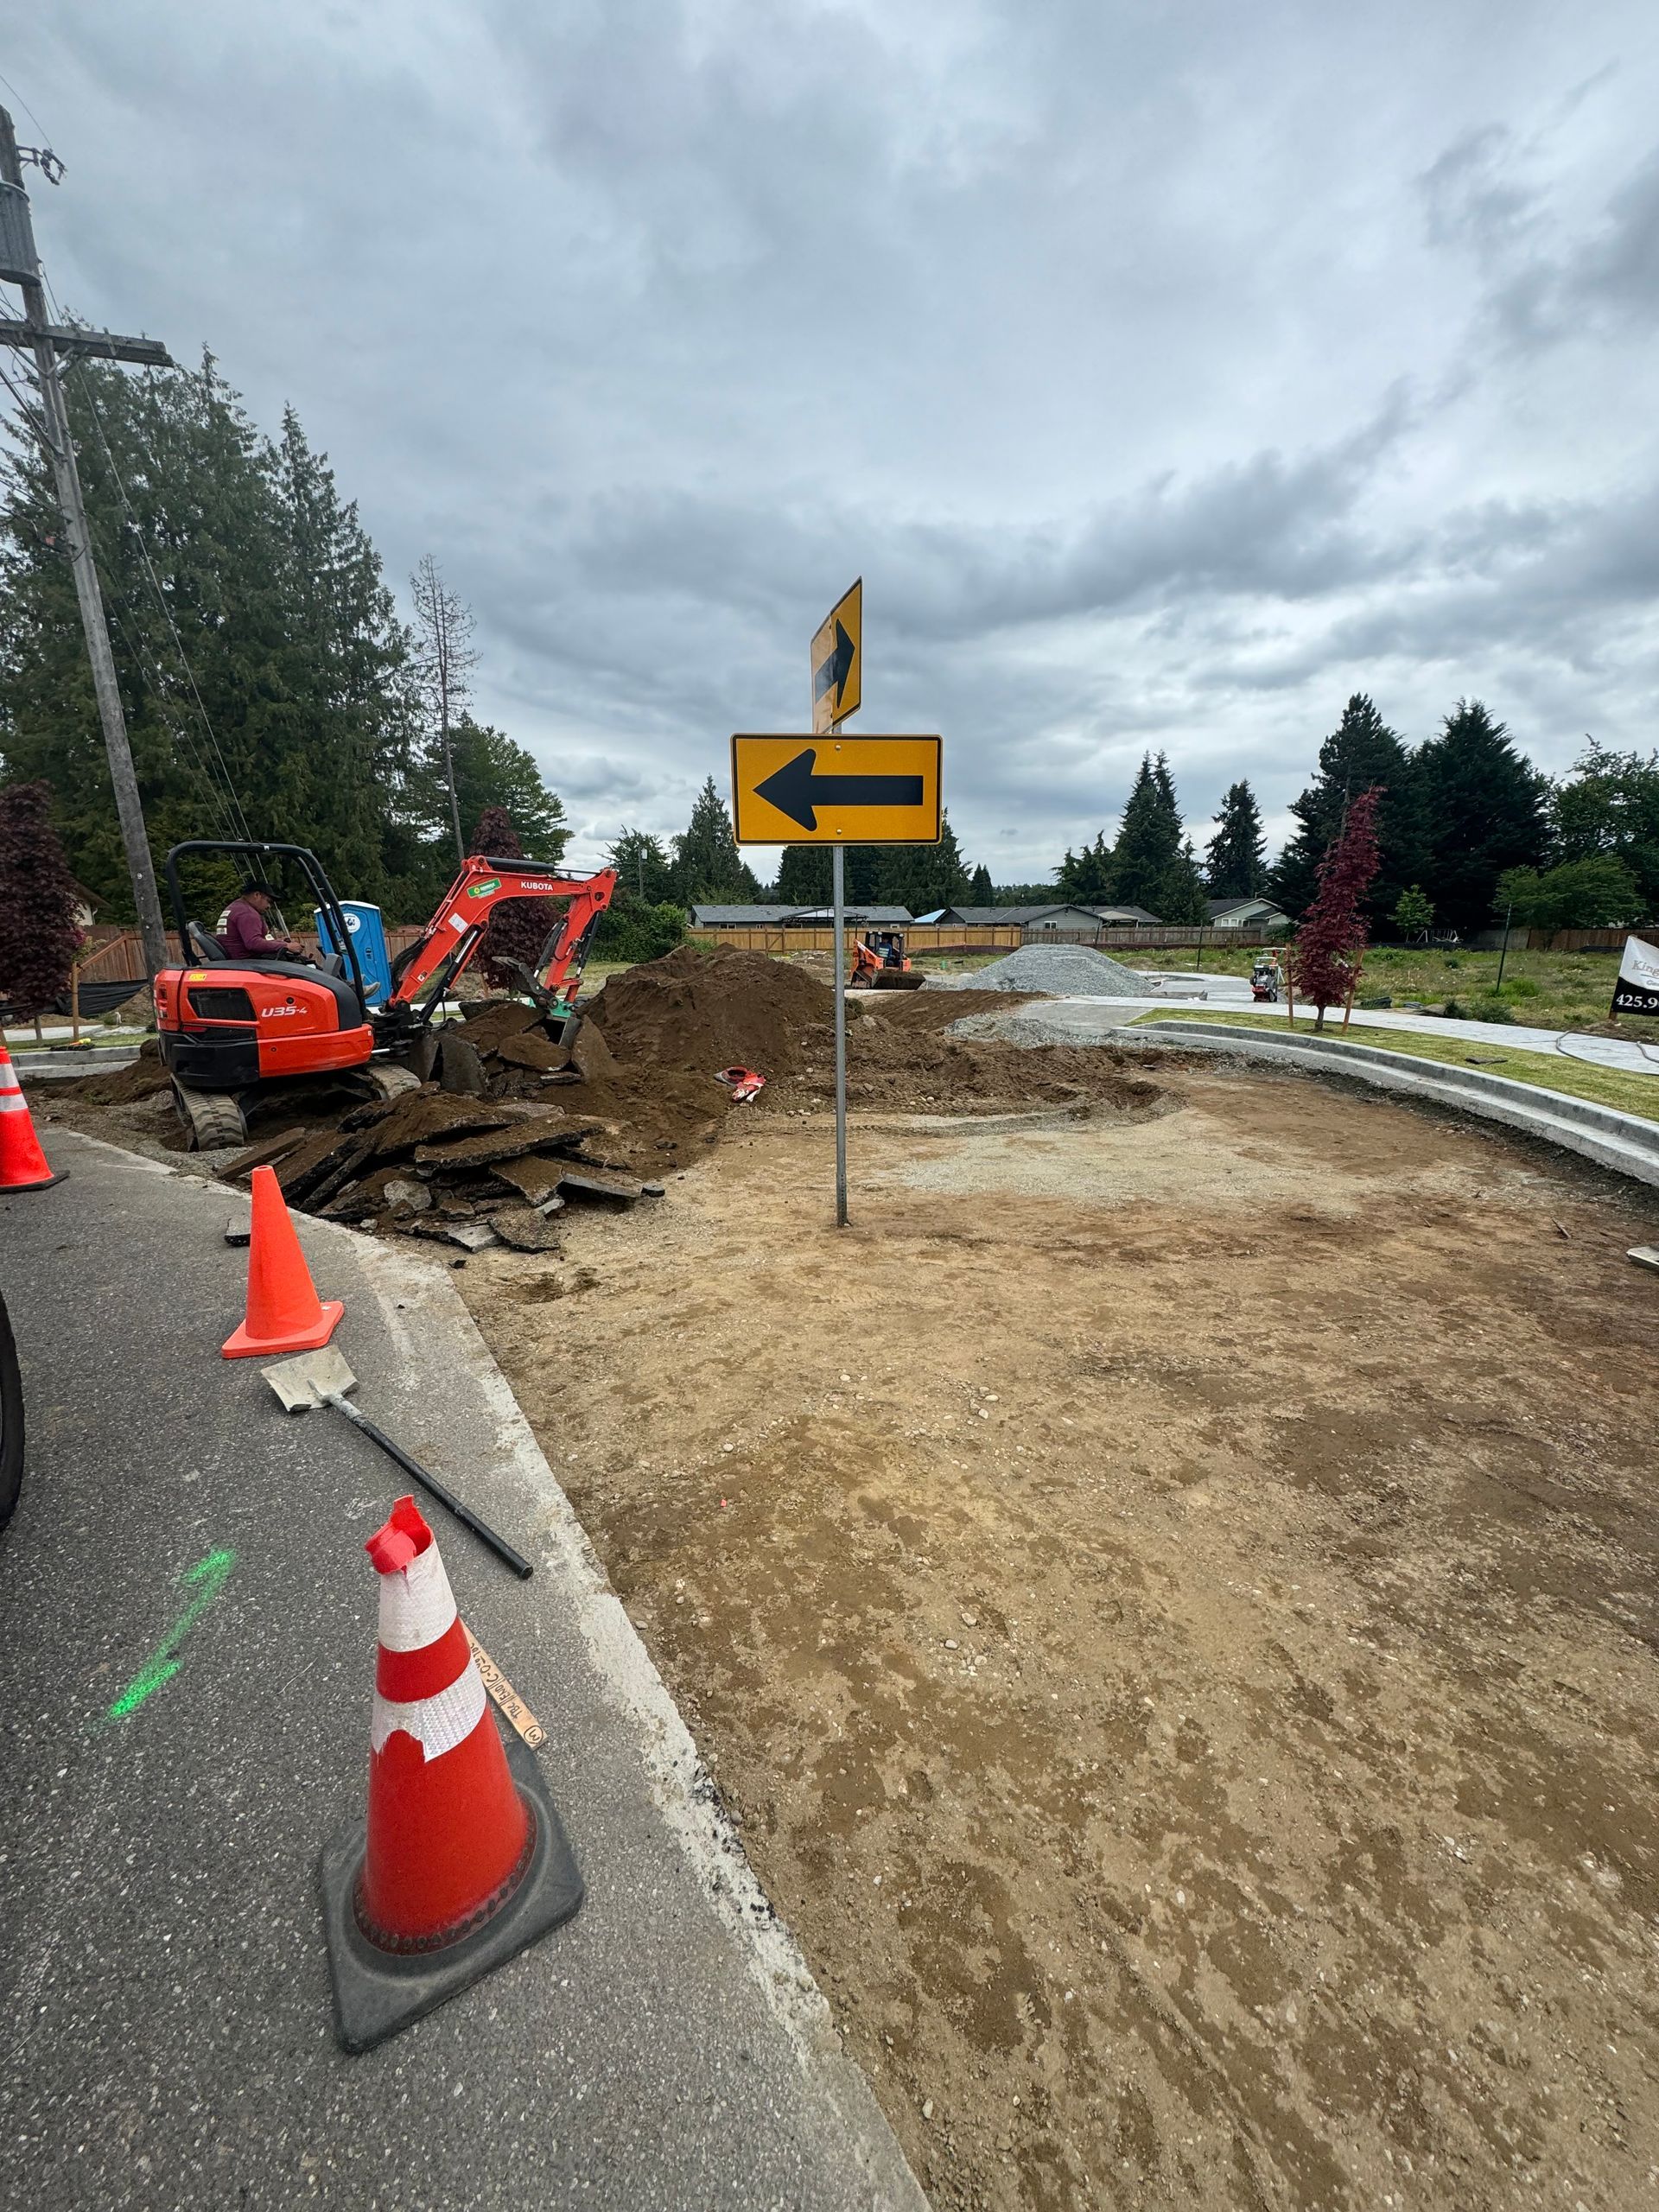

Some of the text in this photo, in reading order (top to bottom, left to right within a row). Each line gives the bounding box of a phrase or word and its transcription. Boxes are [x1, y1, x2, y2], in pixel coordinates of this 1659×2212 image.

[521, 881, 553, 891] KUBOTA
[1616, 994, 1659, 1008] 425.9
[261, 1006, 308, 1018] U35-4
[494, 1684, 511, 1700] END
